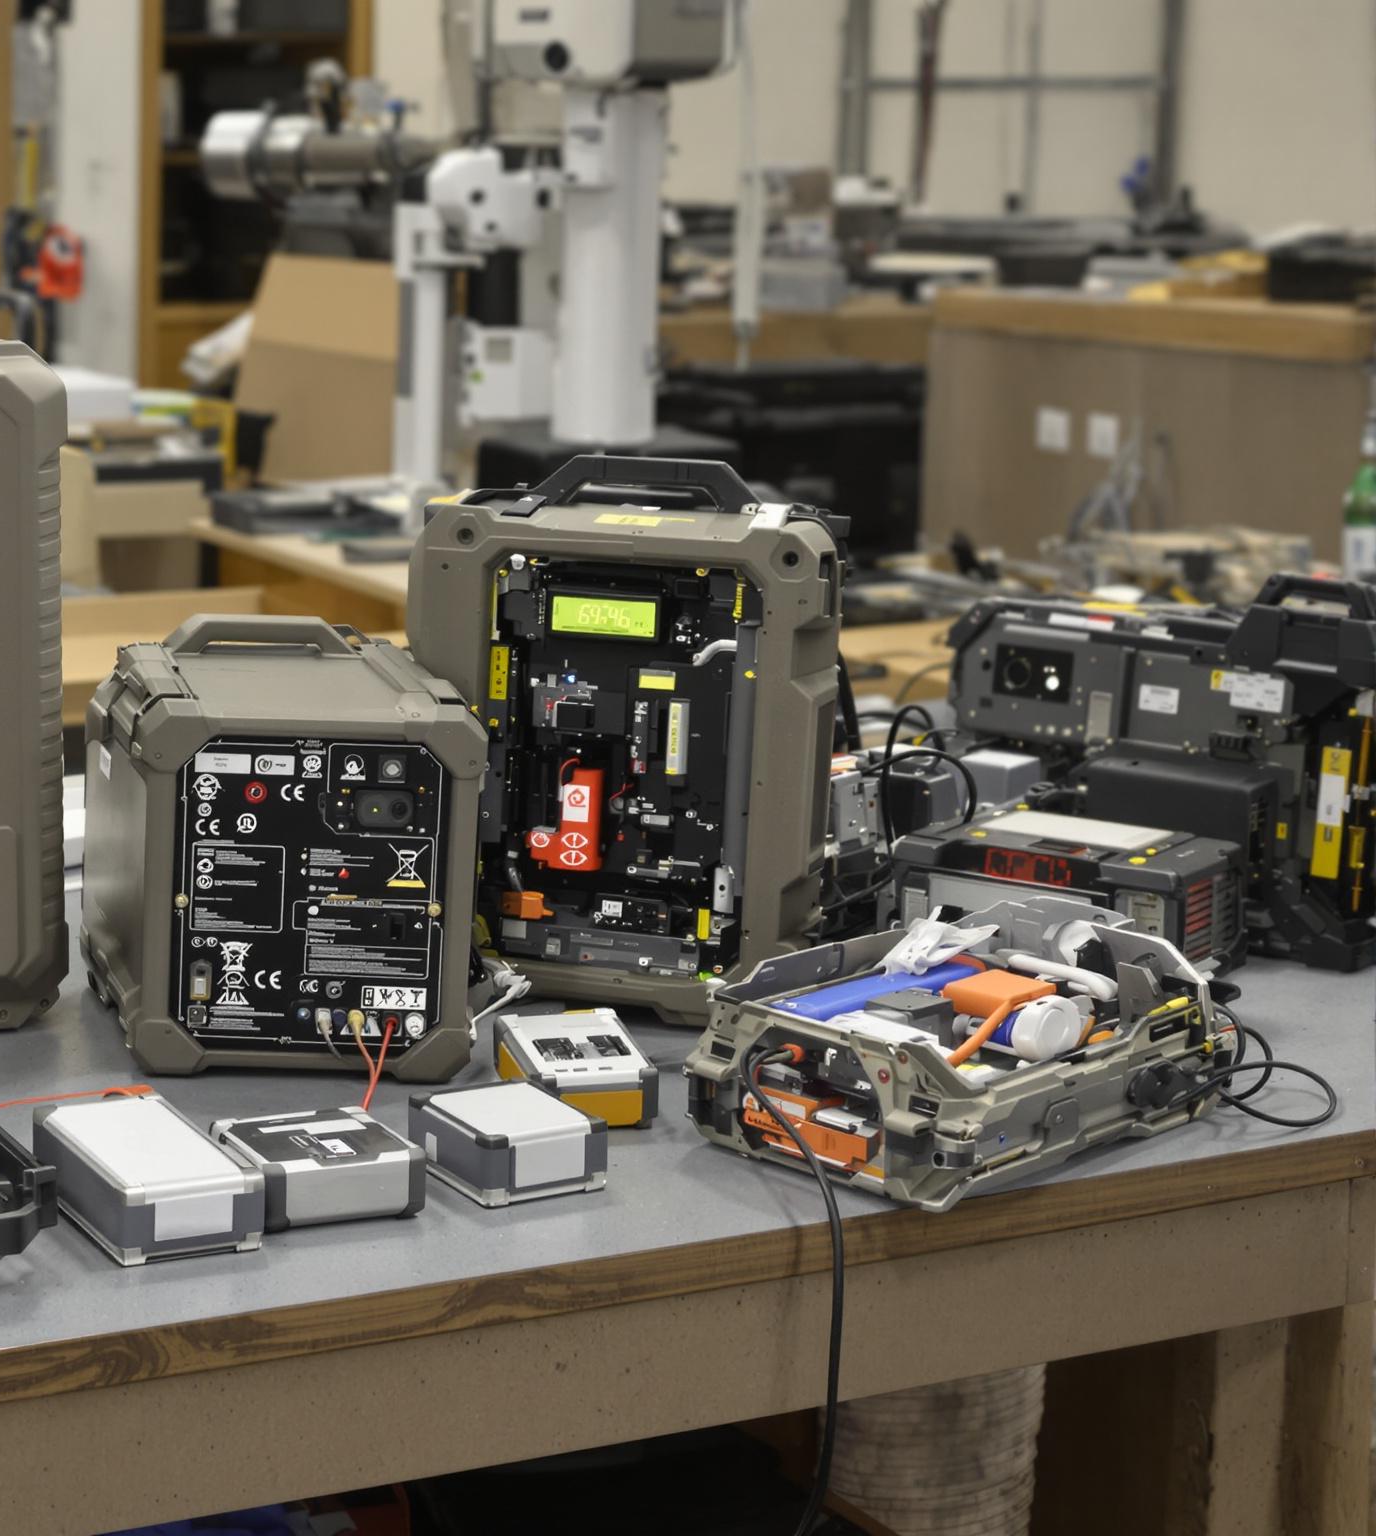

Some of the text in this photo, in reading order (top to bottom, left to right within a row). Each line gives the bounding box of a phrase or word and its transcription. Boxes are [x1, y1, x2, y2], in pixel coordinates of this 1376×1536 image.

[280, 783, 306, 801] CE
[194, 818, 220, 835] CE
[254, 969, 282, 989] CE
